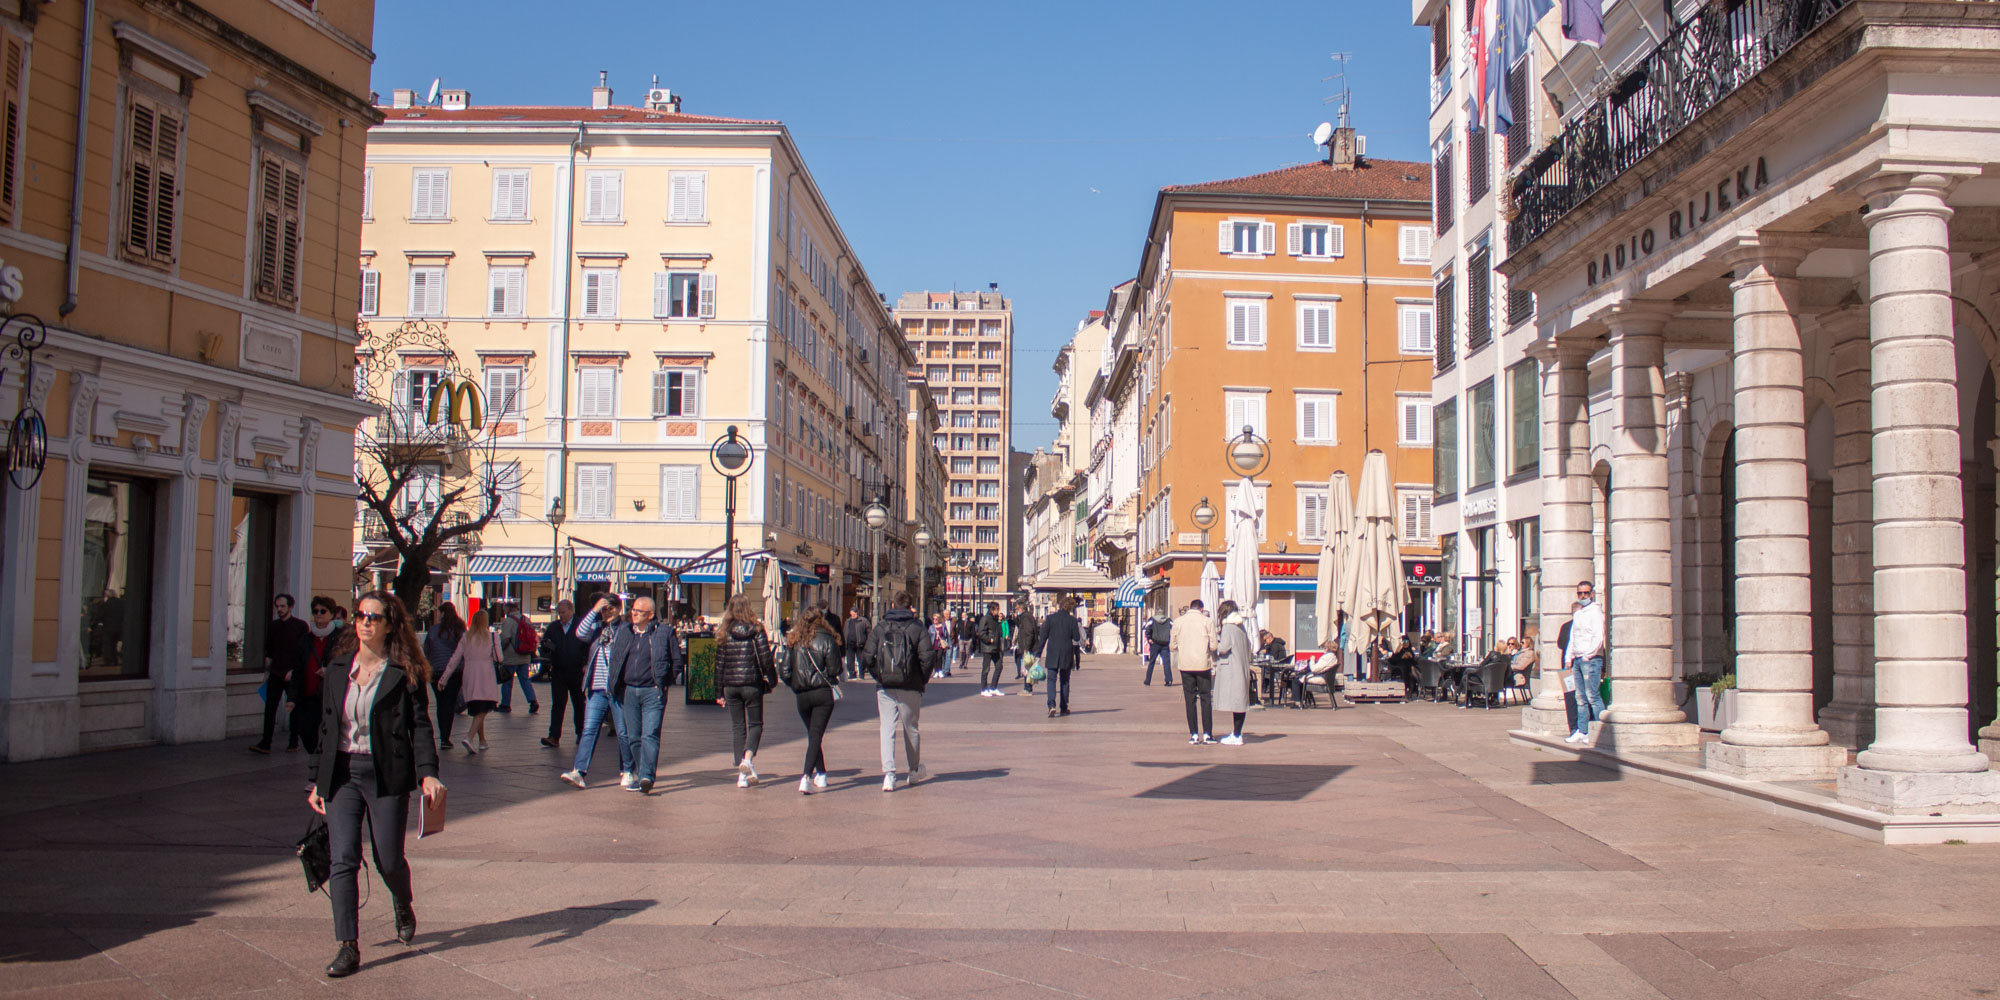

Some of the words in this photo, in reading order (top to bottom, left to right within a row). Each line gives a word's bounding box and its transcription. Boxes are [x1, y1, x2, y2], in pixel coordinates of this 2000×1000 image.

[1588, 229, 1655, 286] RADIO
[1669, 156, 1769, 240] RIJEKA
[1259, 562, 1300, 575] TISAK
